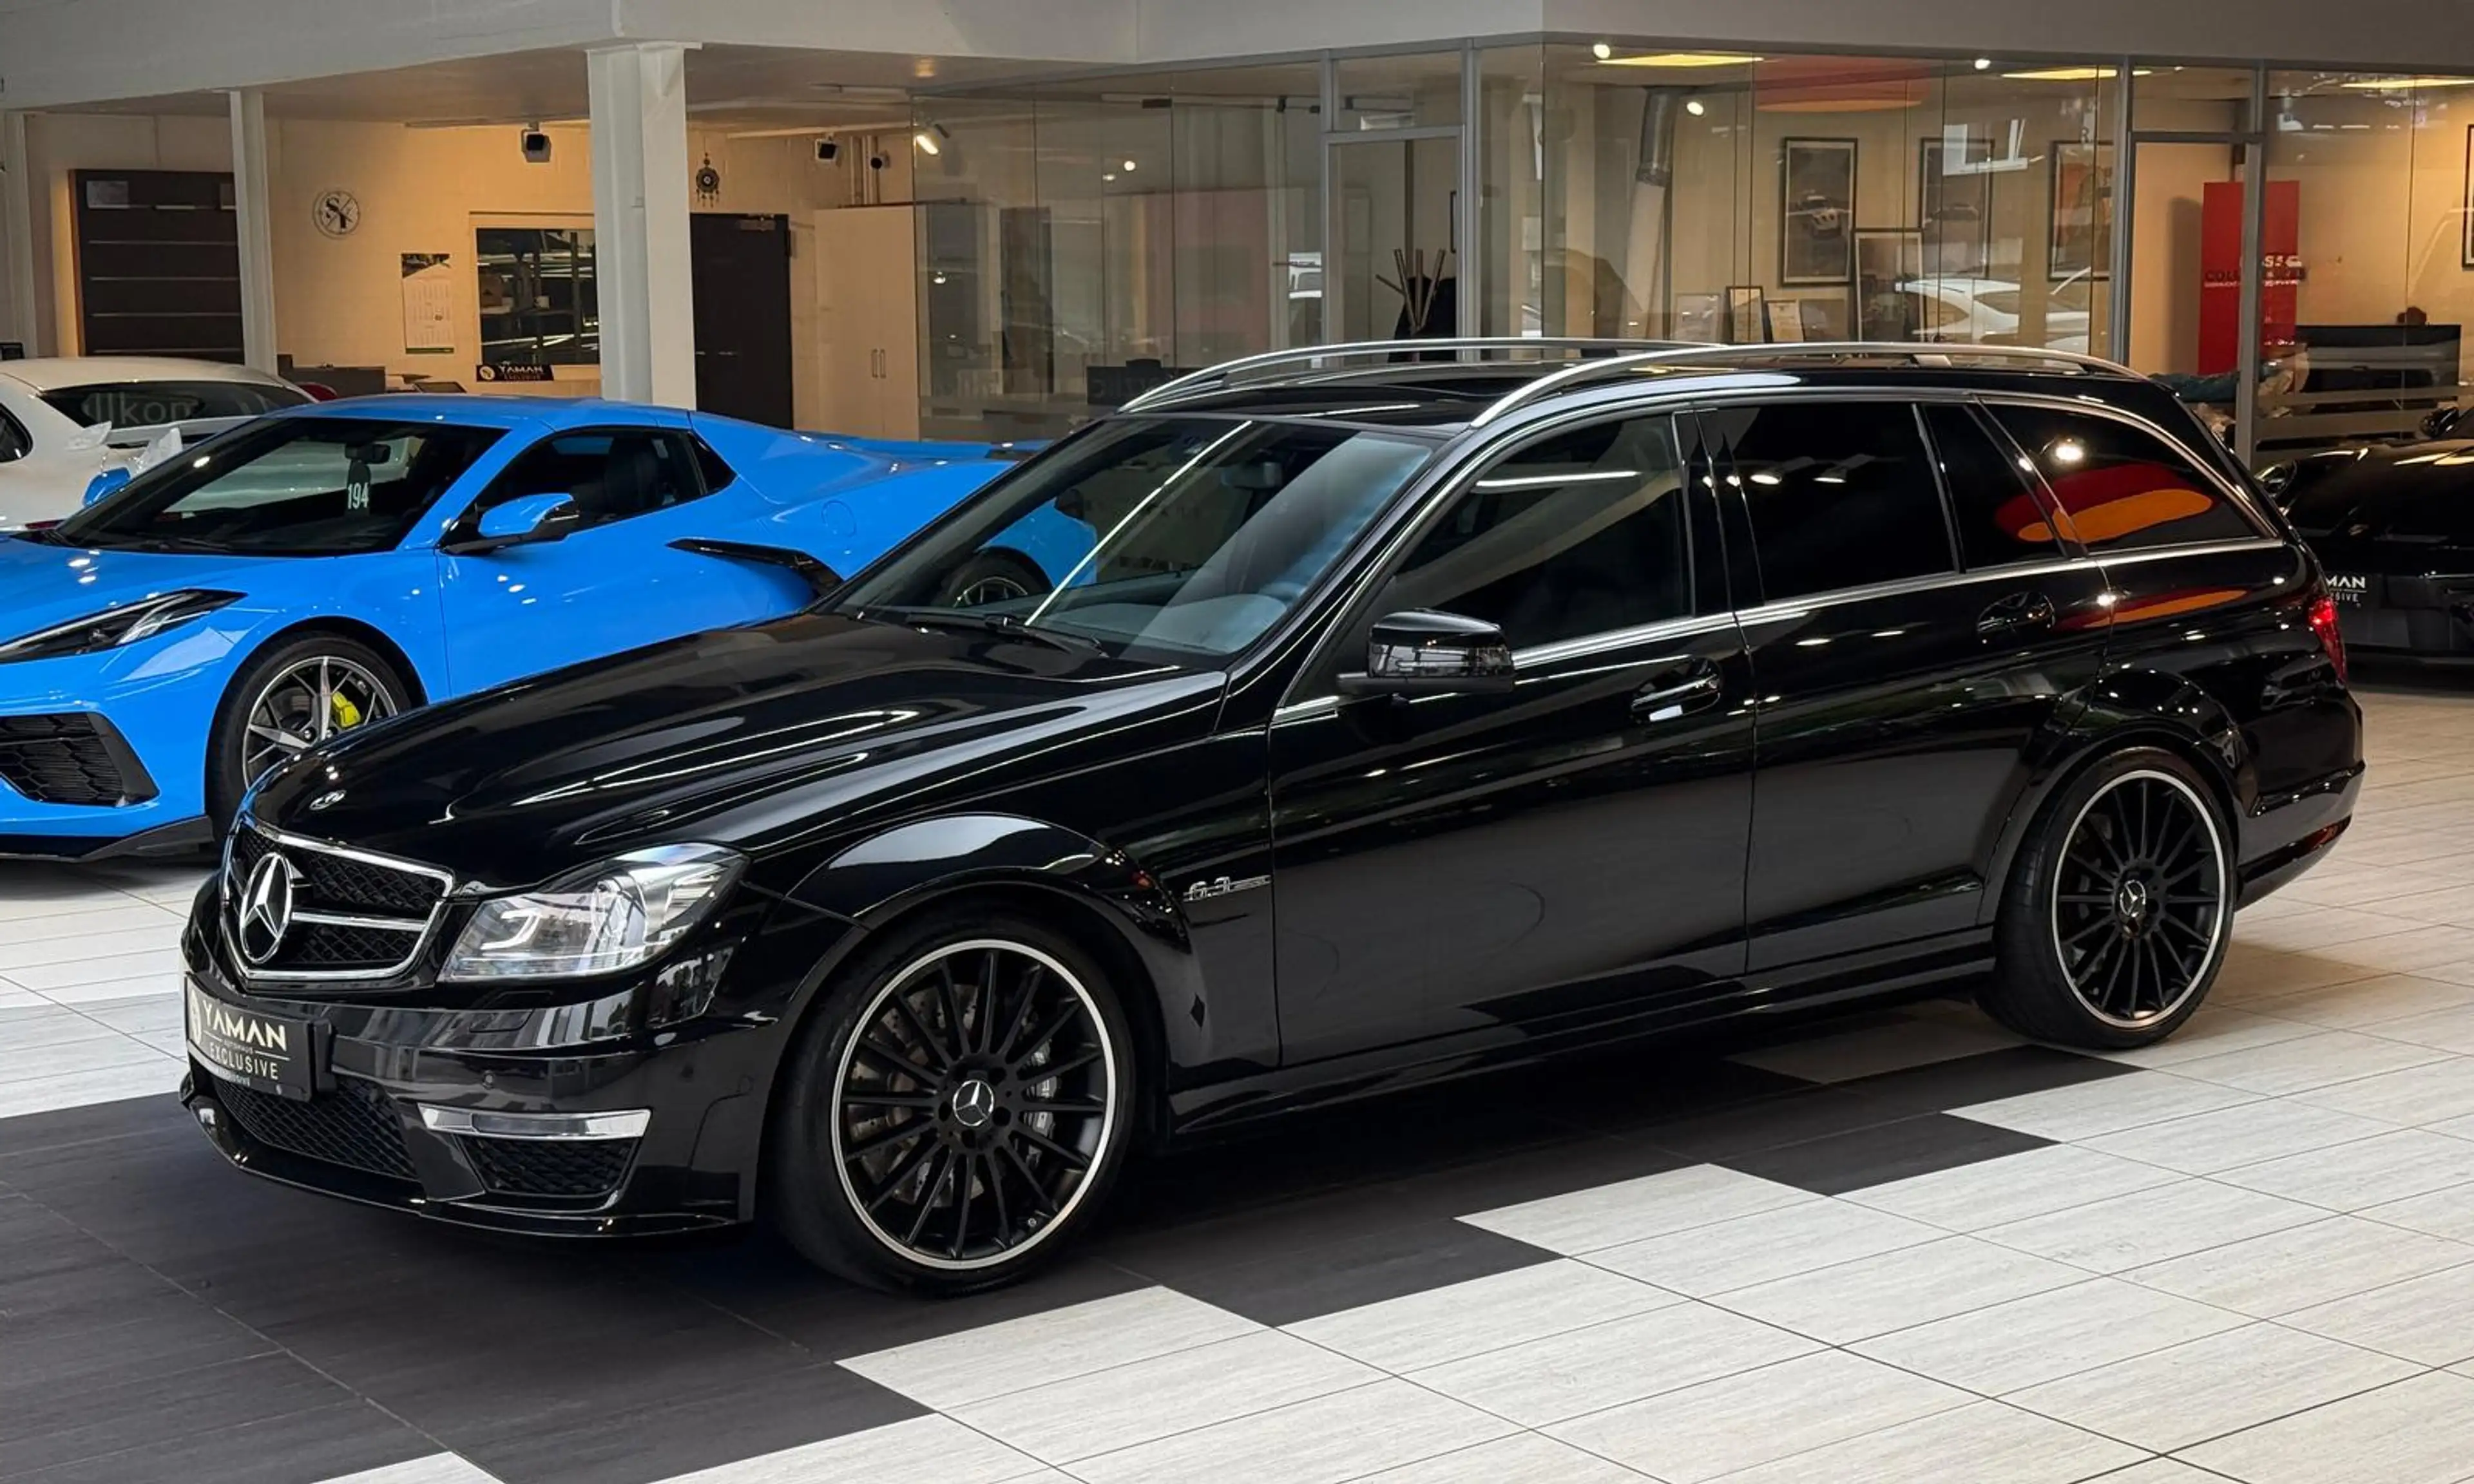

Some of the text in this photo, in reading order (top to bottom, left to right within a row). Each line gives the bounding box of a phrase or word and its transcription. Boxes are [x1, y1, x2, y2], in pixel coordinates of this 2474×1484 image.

[348, 482, 369, 509] 194
[202, 999, 287, 1052] YAMAN
[209, 1042, 279, 1080] EXCLUSIVE
